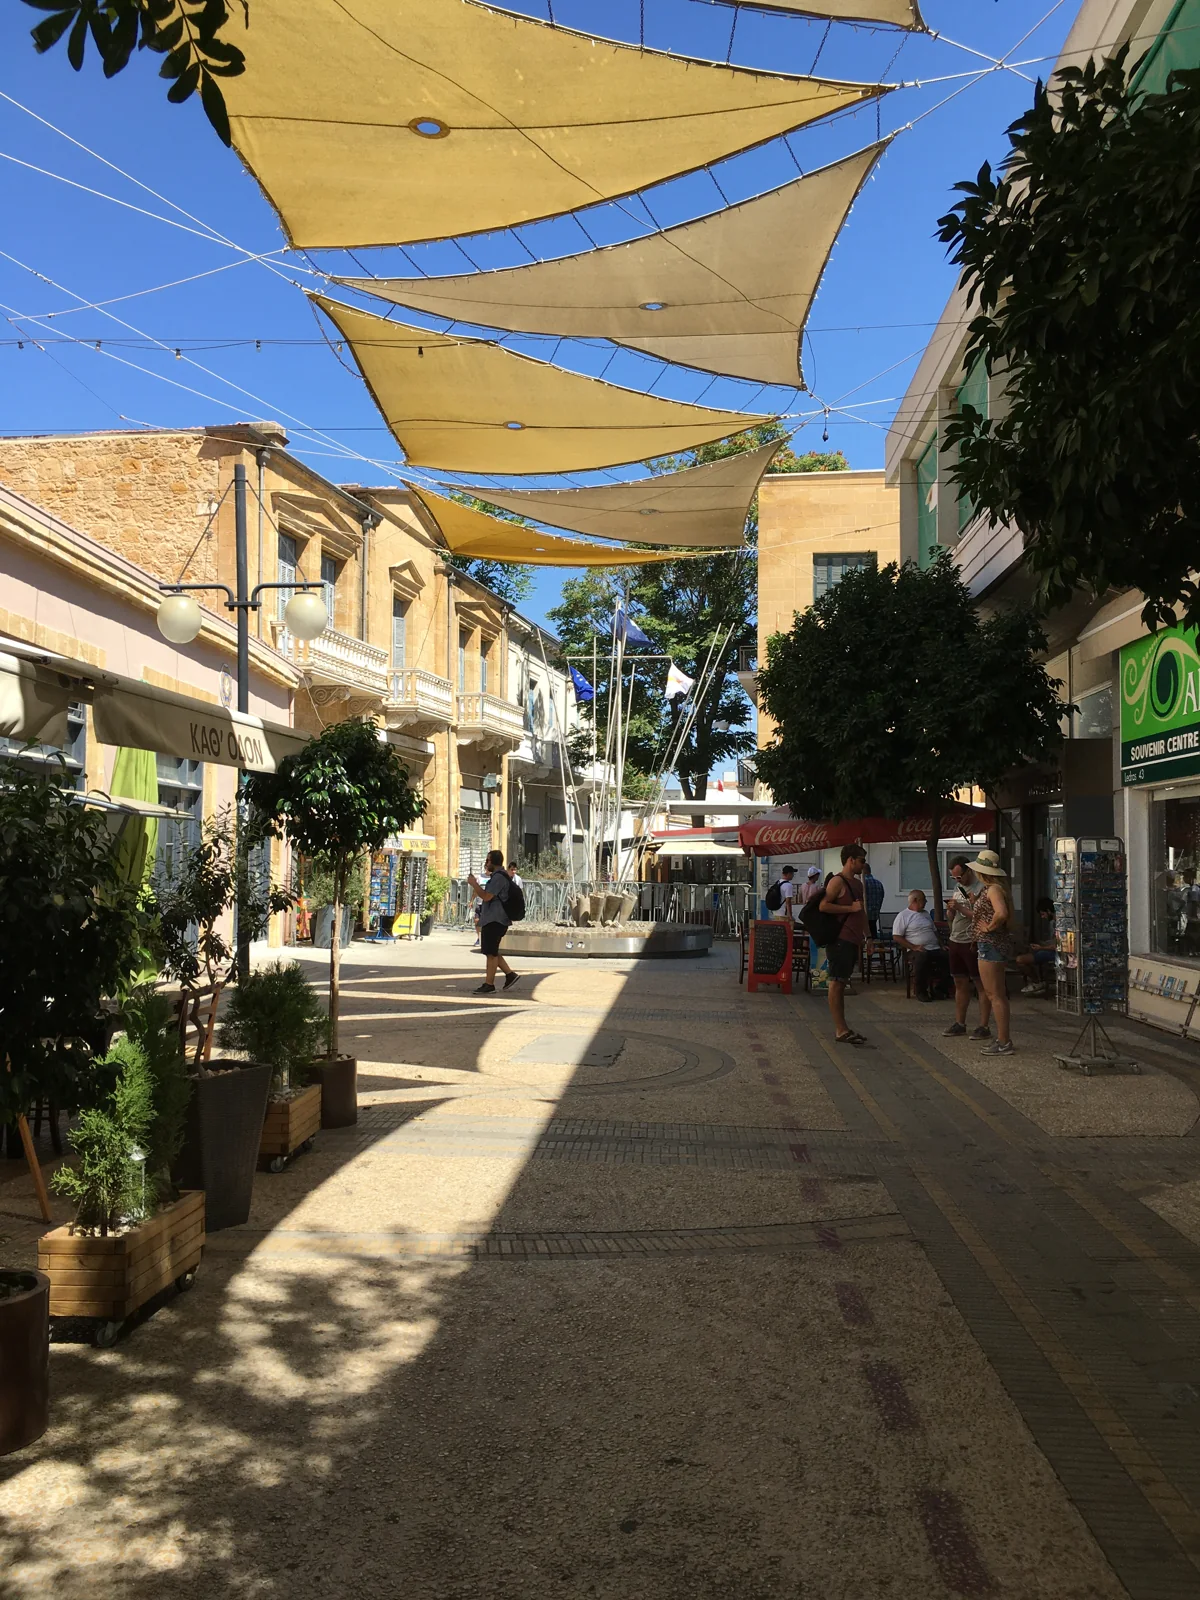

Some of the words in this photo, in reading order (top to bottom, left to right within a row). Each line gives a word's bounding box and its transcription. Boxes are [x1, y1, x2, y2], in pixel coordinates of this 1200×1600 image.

[227, 731, 264, 766] ΟΔΟΝ
[1130, 739, 1165, 762] SOUVENIR
[1167, 730, 1200, 753] CENTRE
[1138, 768, 1145, 780] 43
[754, 823, 829, 846] Coca-Cola
